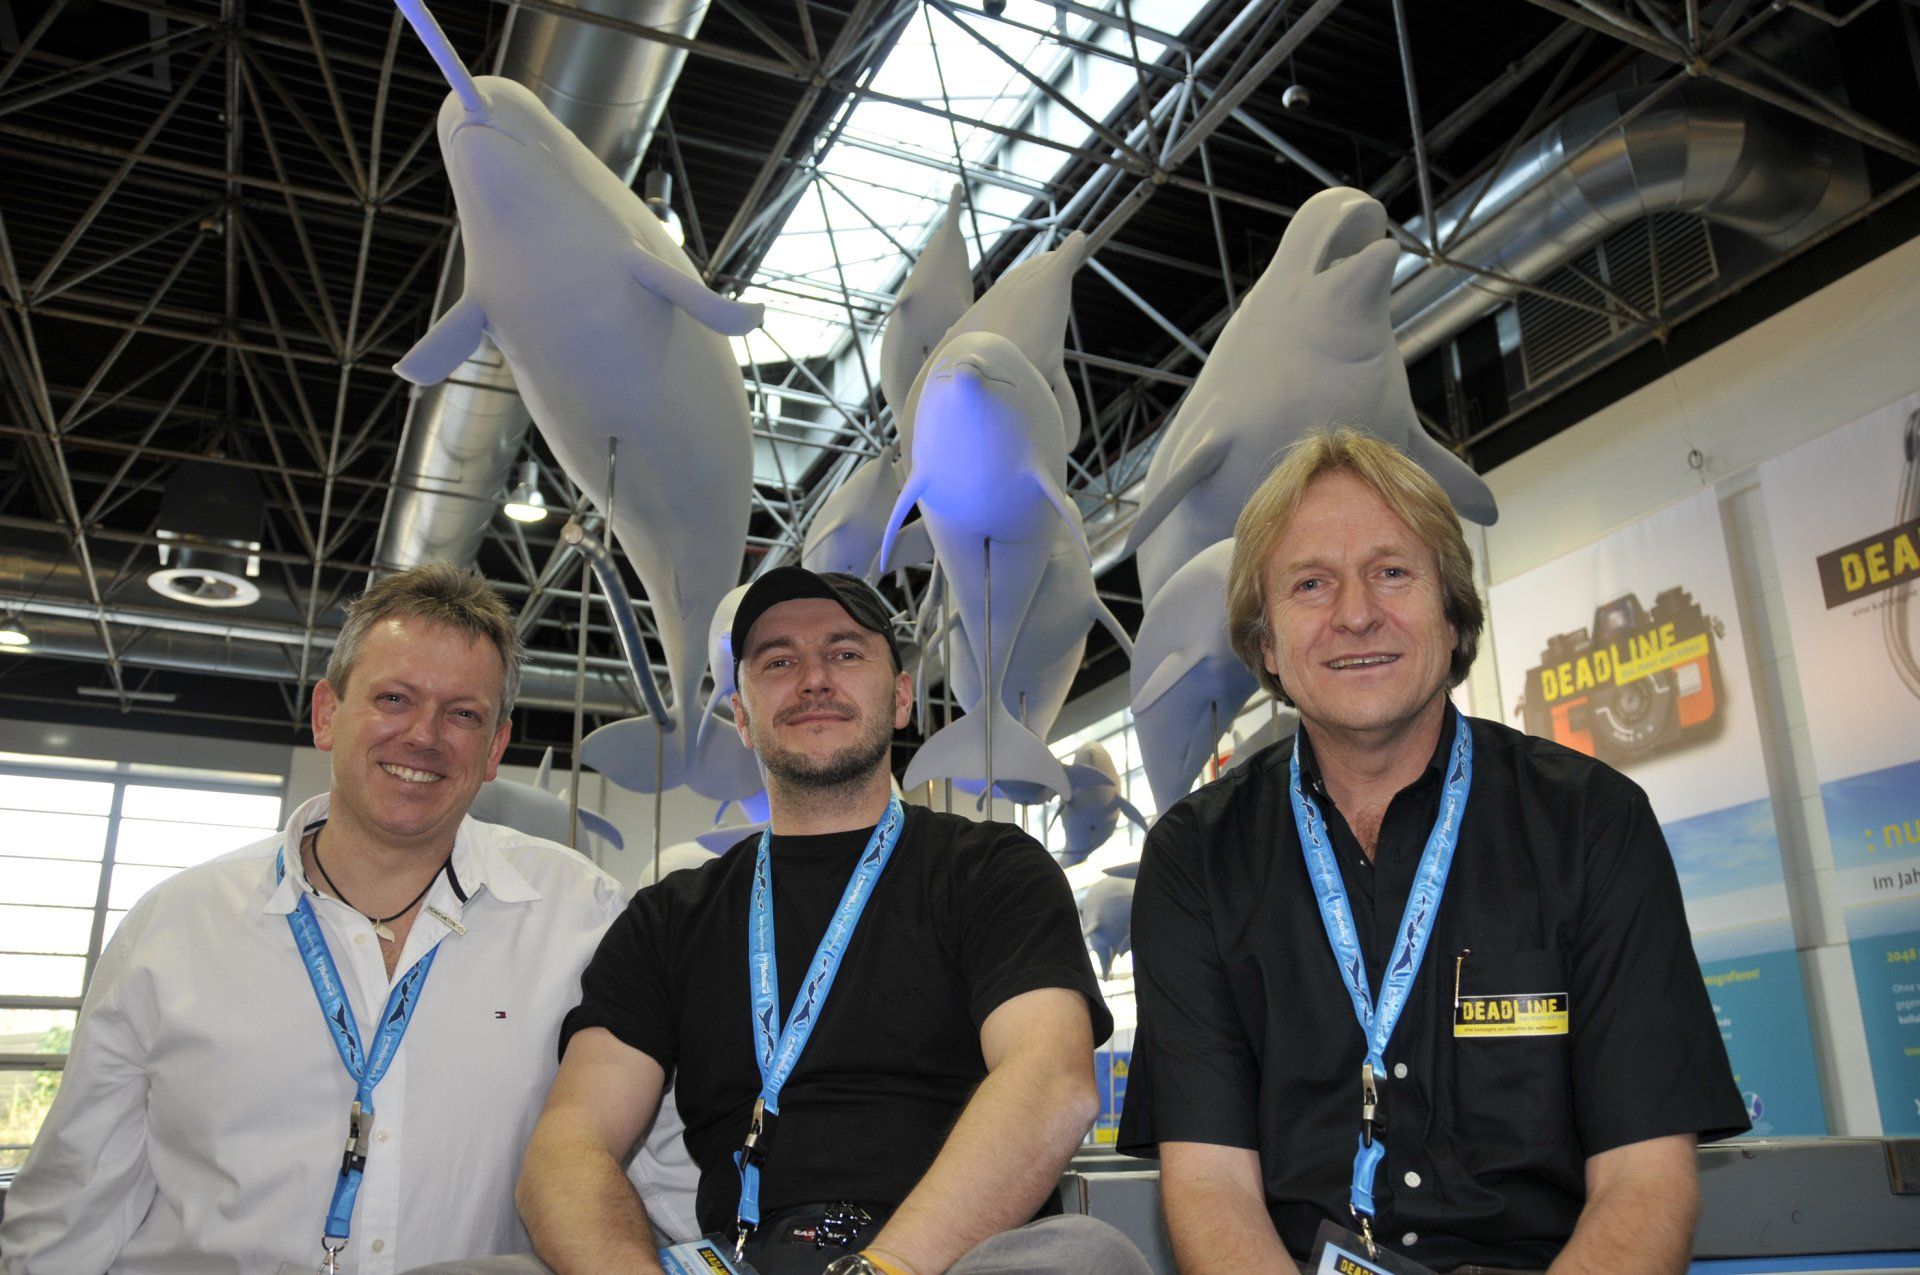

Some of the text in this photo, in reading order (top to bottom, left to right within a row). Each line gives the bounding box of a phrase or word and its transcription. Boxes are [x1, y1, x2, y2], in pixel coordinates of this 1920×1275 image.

[1841, 528, 1920, 592] DEA
[1540, 622, 1677, 702] DEADLINE
[1873, 876, 1894, 890] Im
[1462, 998, 1558, 1025] DEADLINE
